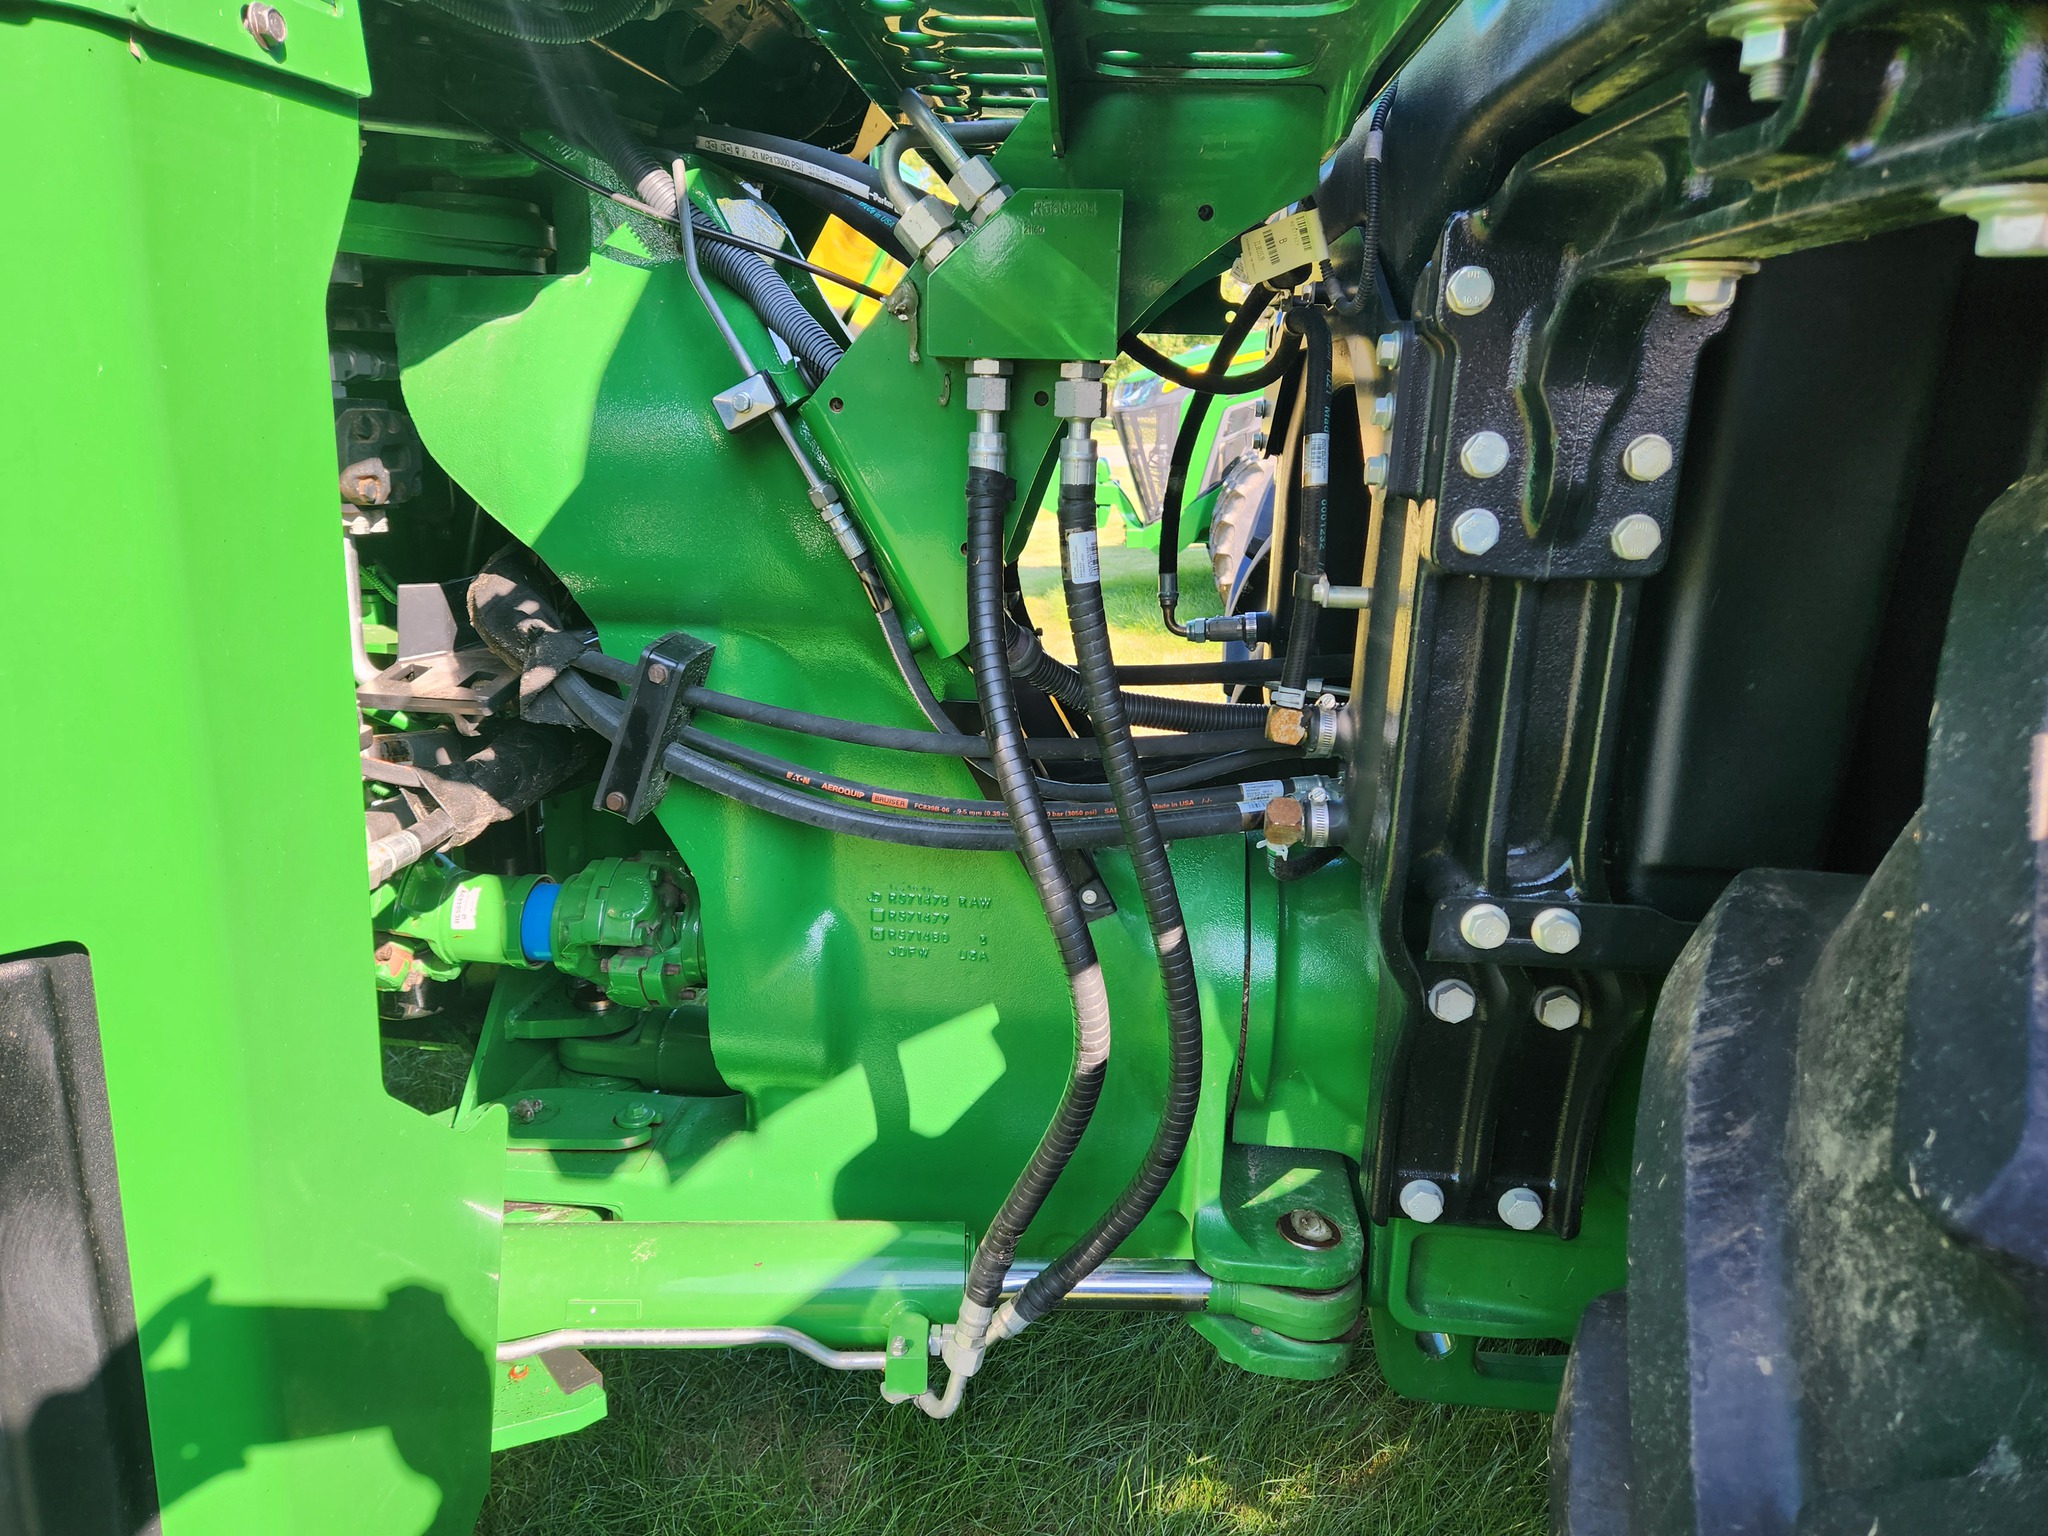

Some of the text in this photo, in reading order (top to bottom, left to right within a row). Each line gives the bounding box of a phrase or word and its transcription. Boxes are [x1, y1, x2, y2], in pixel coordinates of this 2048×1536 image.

[751, 149, 760, 159] 21
[760, 152, 774, 164] MPa
[880, 215, 896, 229] USA
[821, 782, 866, 799] AEROQUIP
[873, 793, 906, 808] BRUISER
[1052, 810, 1064, 818] bar
[1084, 809, 1098, 817] psi)
[1179, 799, 1195, 808] USA
[888, 892, 949, 907] R571478
[959, 895, 992, 909] RAW
[888, 928, 950, 943] R571480
[959, 950, 989, 962] USA
